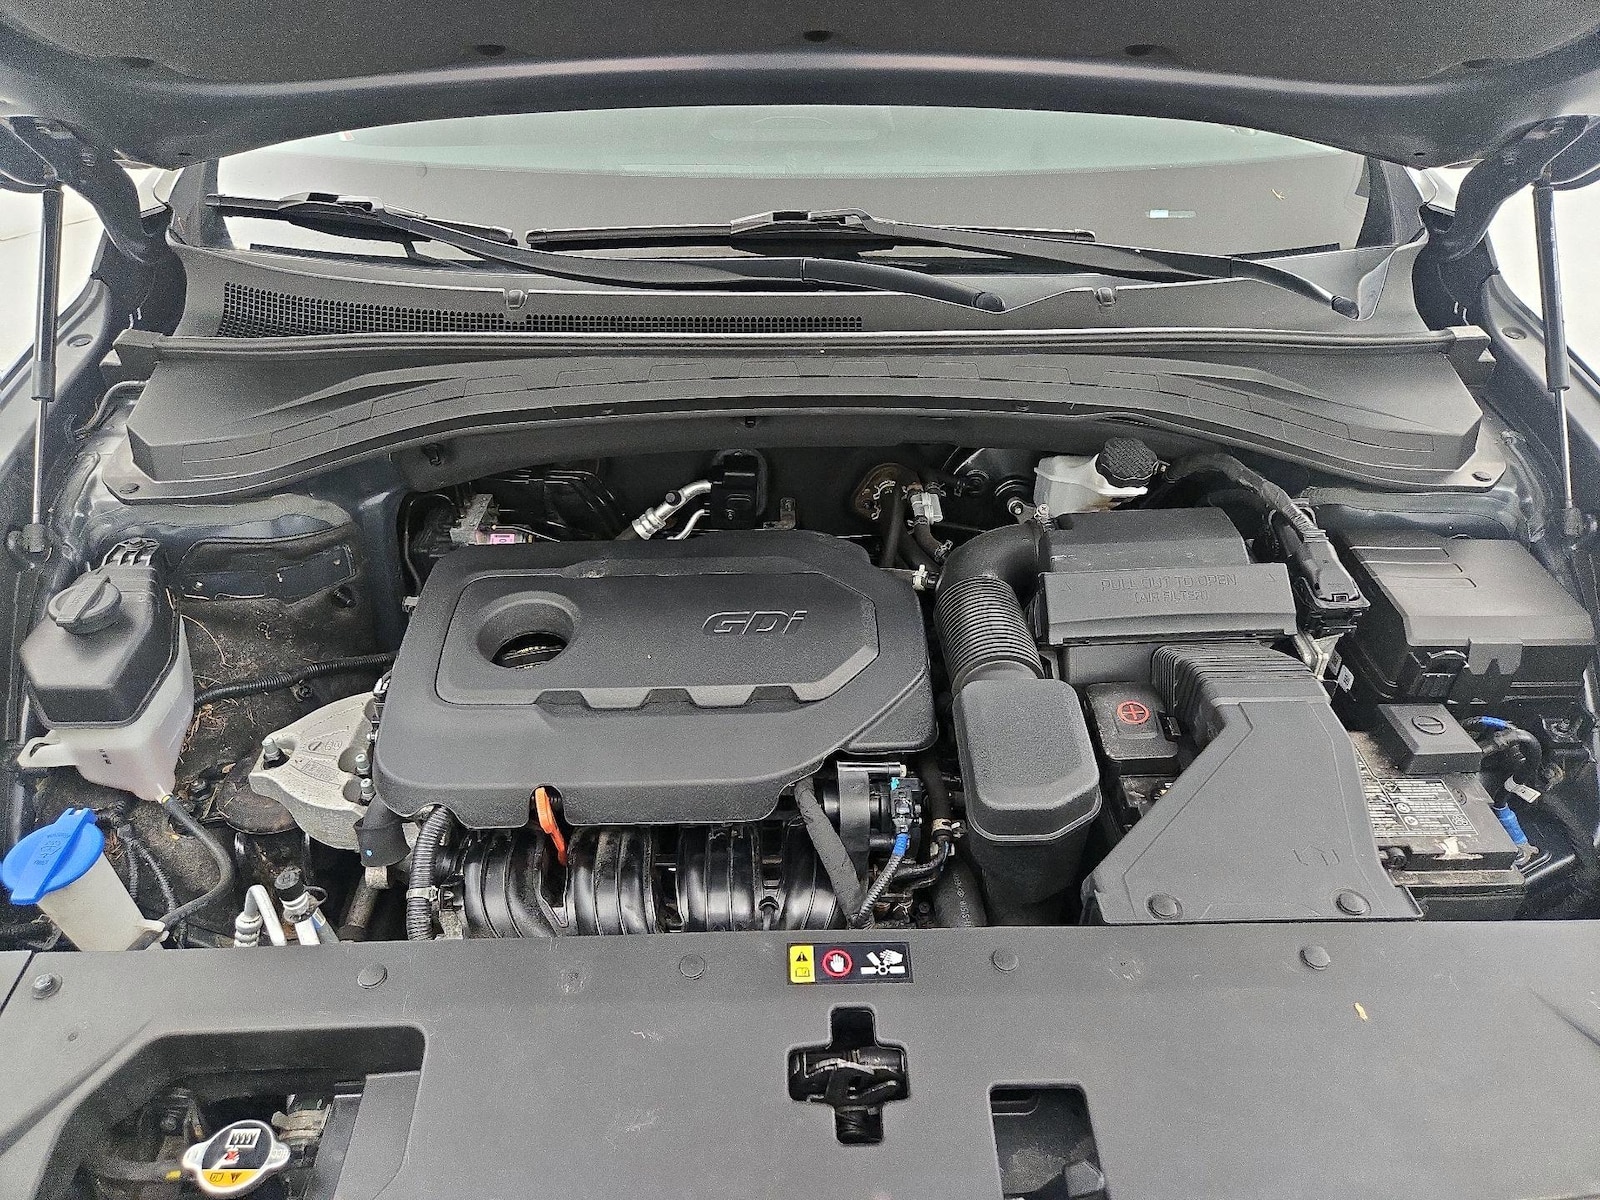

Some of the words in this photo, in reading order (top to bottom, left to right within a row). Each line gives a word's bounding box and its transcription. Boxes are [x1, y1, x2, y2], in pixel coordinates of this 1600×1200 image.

[1101, 577, 1138, 591] PULL
[1142, 576, 1170, 589] OUT
[1174, 575, 1194, 588] TO
[1198, 573, 1237, 586] OPEN
[701, 609, 808, 635] GDi
